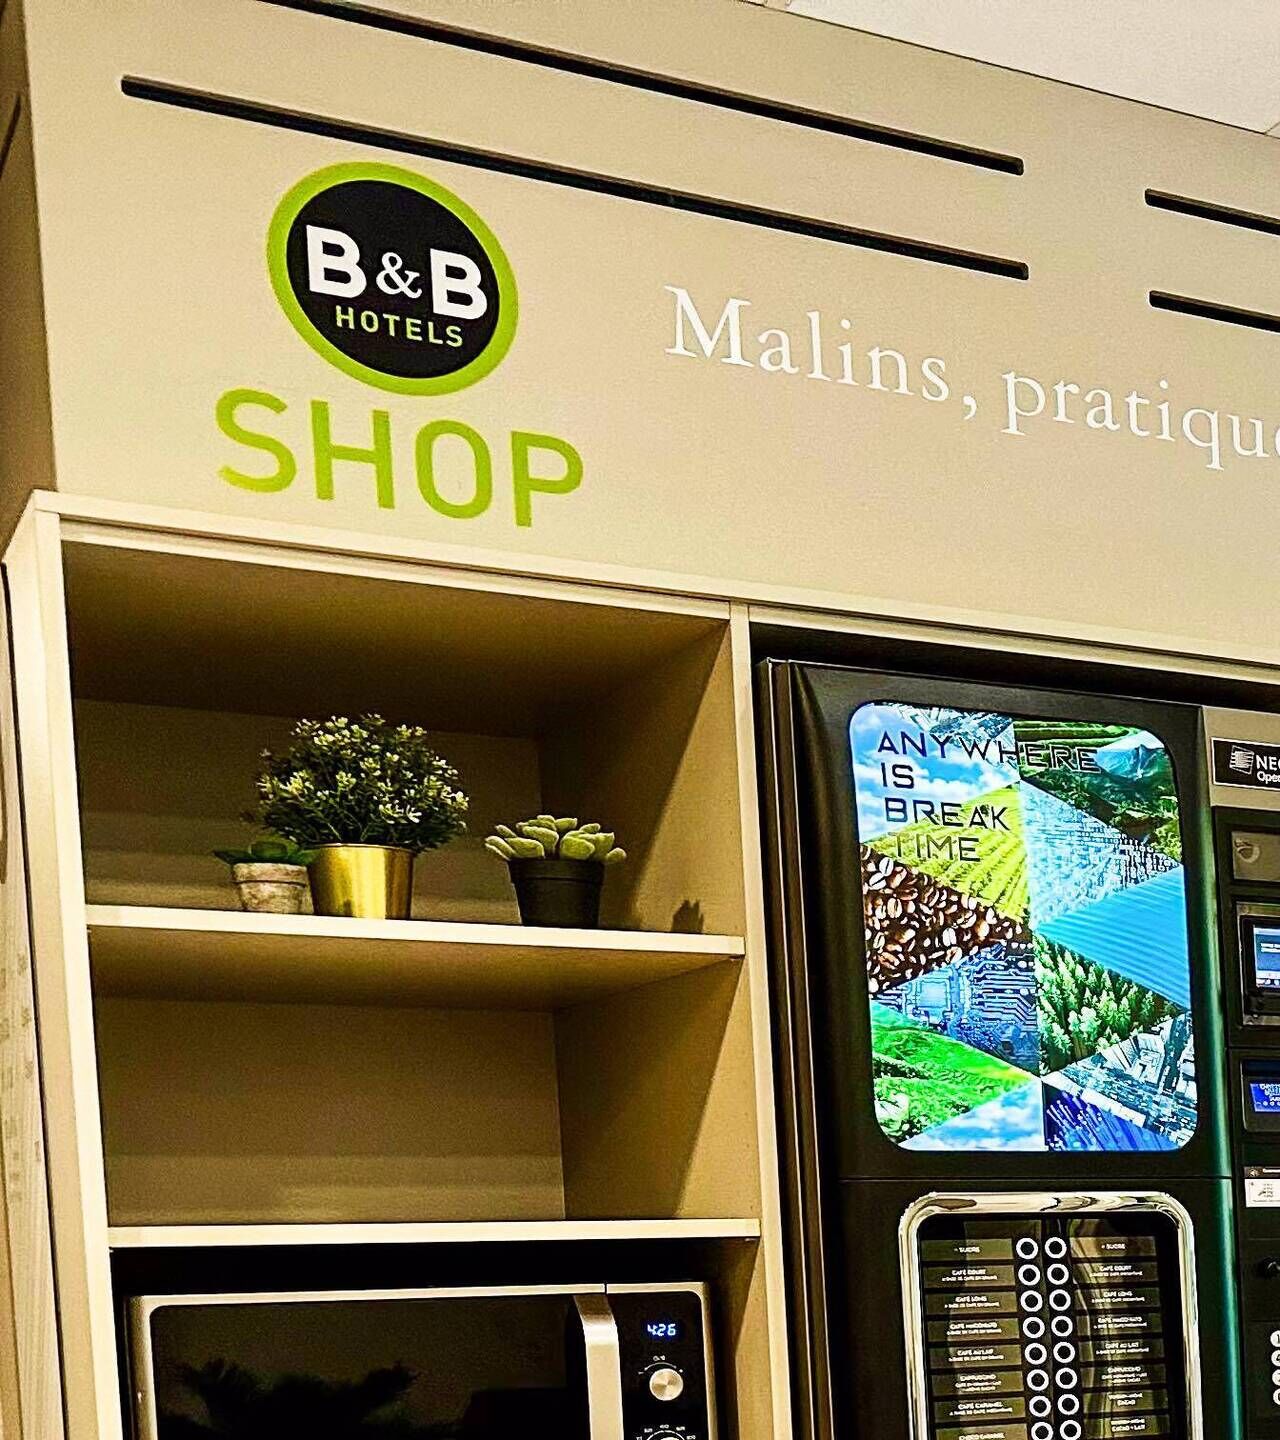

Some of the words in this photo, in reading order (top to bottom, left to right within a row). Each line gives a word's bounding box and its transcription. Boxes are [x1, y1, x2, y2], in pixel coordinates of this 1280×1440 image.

[335, 304, 464, 348] HOTELS
[664, 285, 978, 421] Malins,
[215, 388, 584, 528] SHOP
[877, 729, 1101, 774] ANYWHERE
[880, 761, 915, 790] IS
[884, 796, 1011, 831] BREAK
[888, 831, 981, 863] TIME
